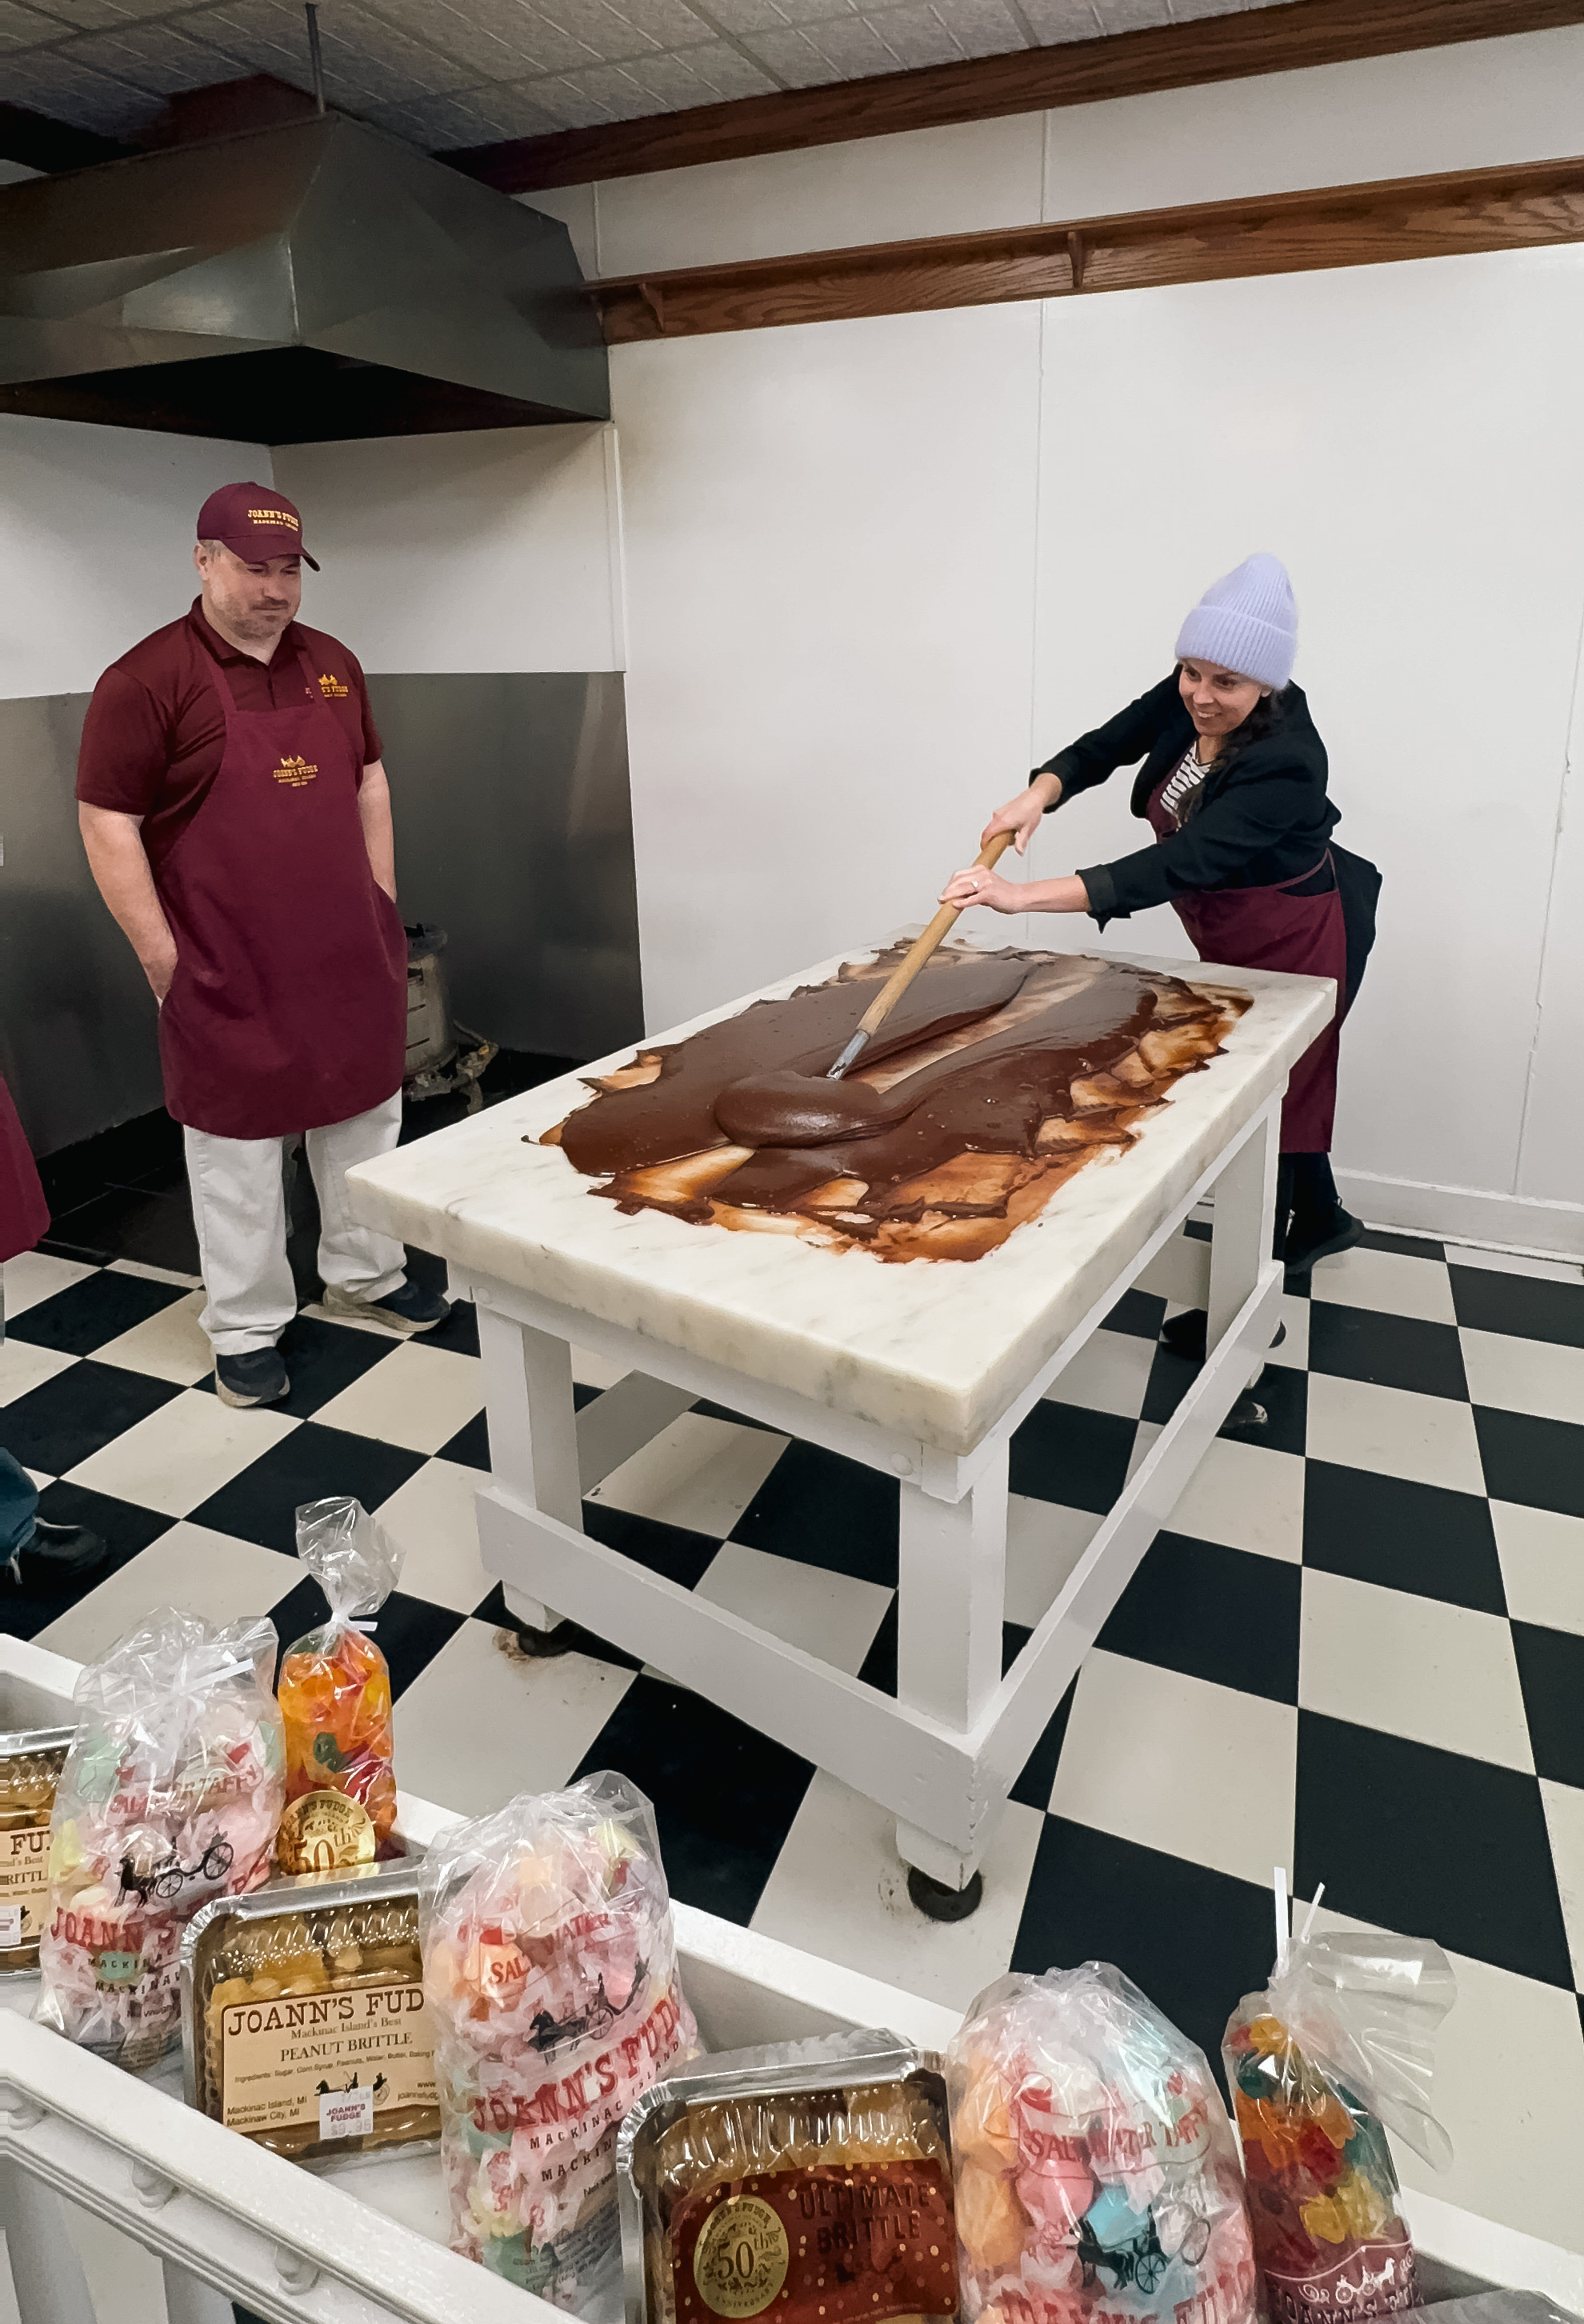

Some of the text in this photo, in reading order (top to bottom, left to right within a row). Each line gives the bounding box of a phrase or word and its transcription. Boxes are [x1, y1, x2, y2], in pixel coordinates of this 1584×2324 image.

[227, 1995, 355, 2036] JOANN'S
[290, 2016, 402, 2040] Mackinac Island's Best
[280, 2032, 414, 2062] PEANUT BRITTLE
[226, 2095, 307, 2116] Mackinac Island, MI
[473, 2051, 619, 2133] JOANN'S
[530, 2040, 680, 2150] MACKINAC ISLAND
[226, 2107, 300, 2127] Mackinaw City, MI
[326, 2102, 366, 2117] JOANN'S
[330, 2110, 362, 2122] FUDGE
[800, 2181, 930, 2220] ULTIMATE
[816, 2213, 921, 2254] BRITTLE
